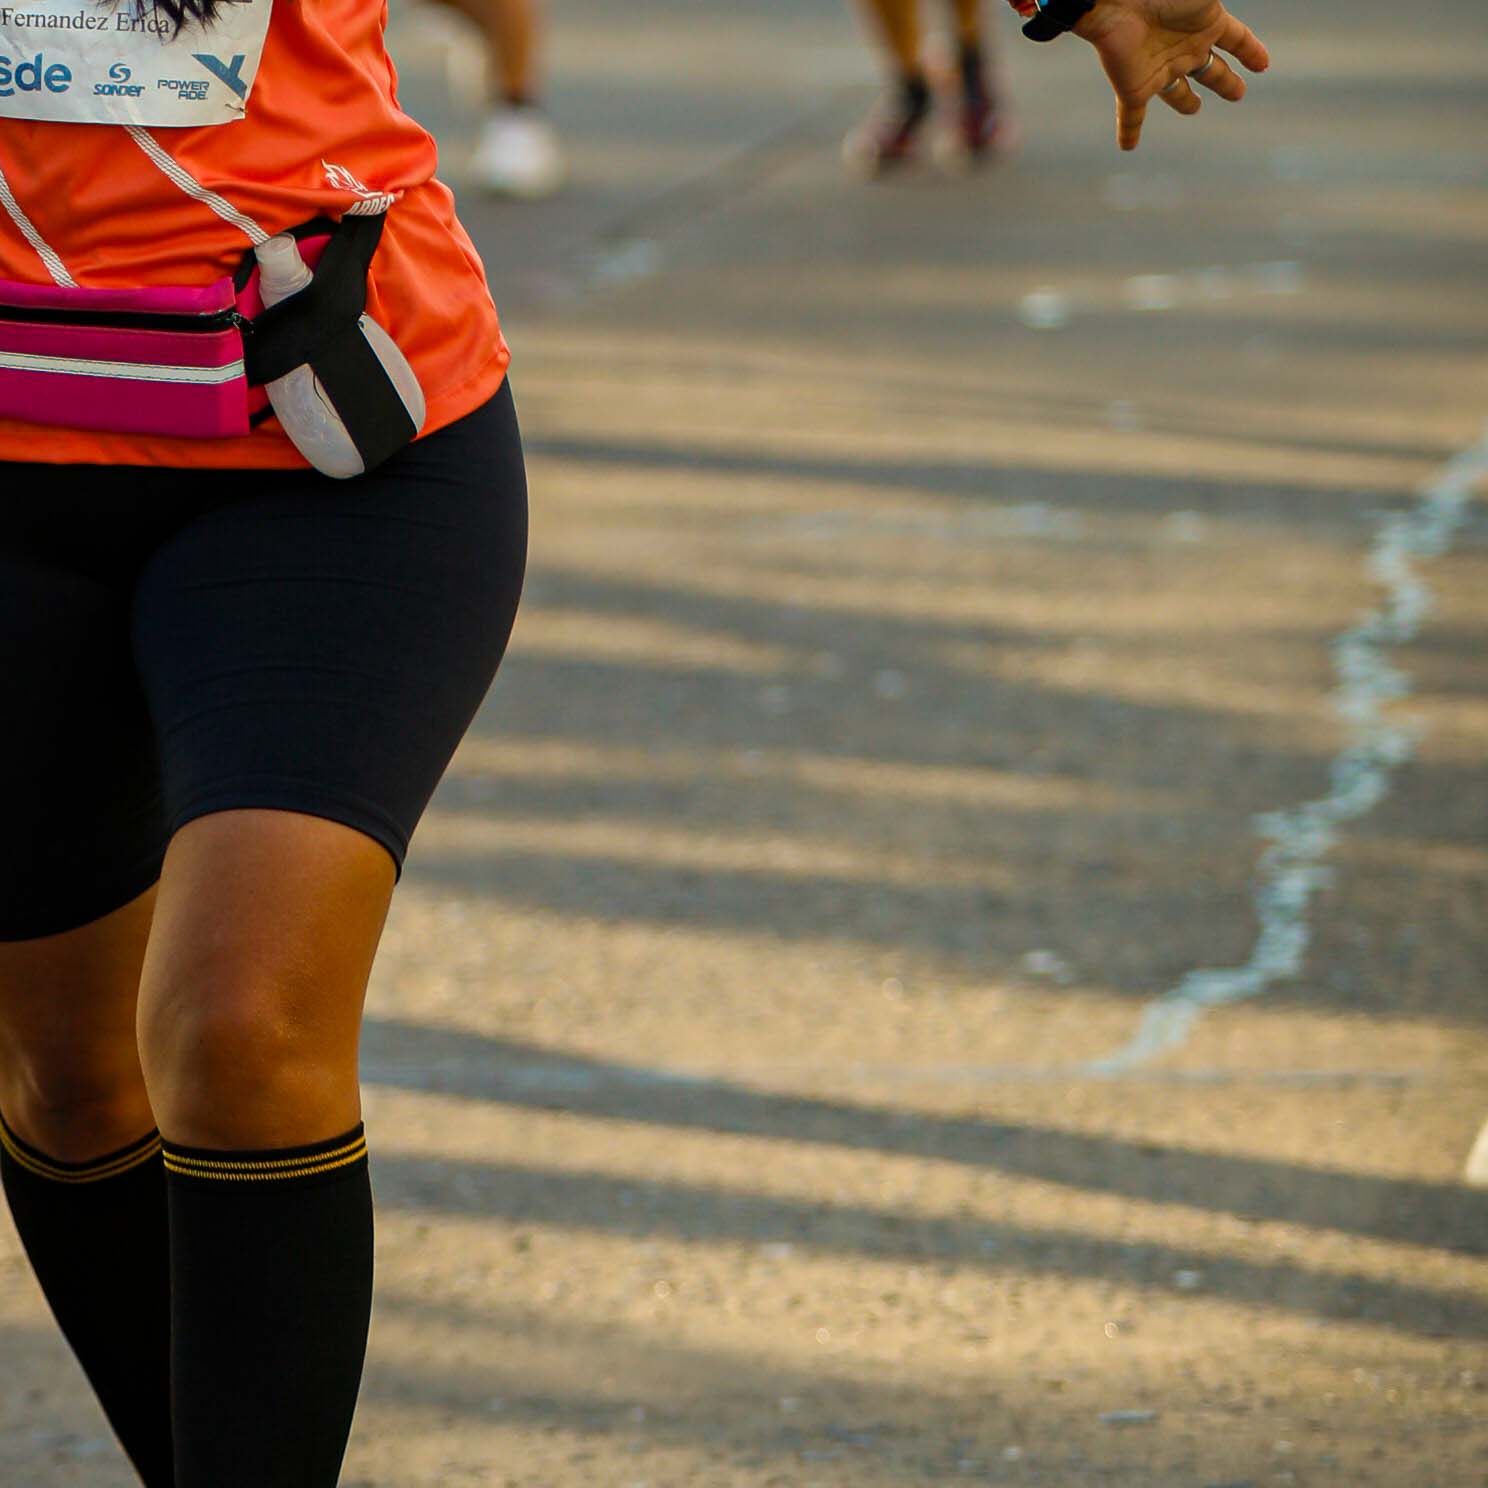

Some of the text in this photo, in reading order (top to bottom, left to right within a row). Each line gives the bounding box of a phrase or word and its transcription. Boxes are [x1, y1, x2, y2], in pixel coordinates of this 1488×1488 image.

[0, 7, 170, 34] Fernandez Erica
[157, 79, 210, 91] POWER
